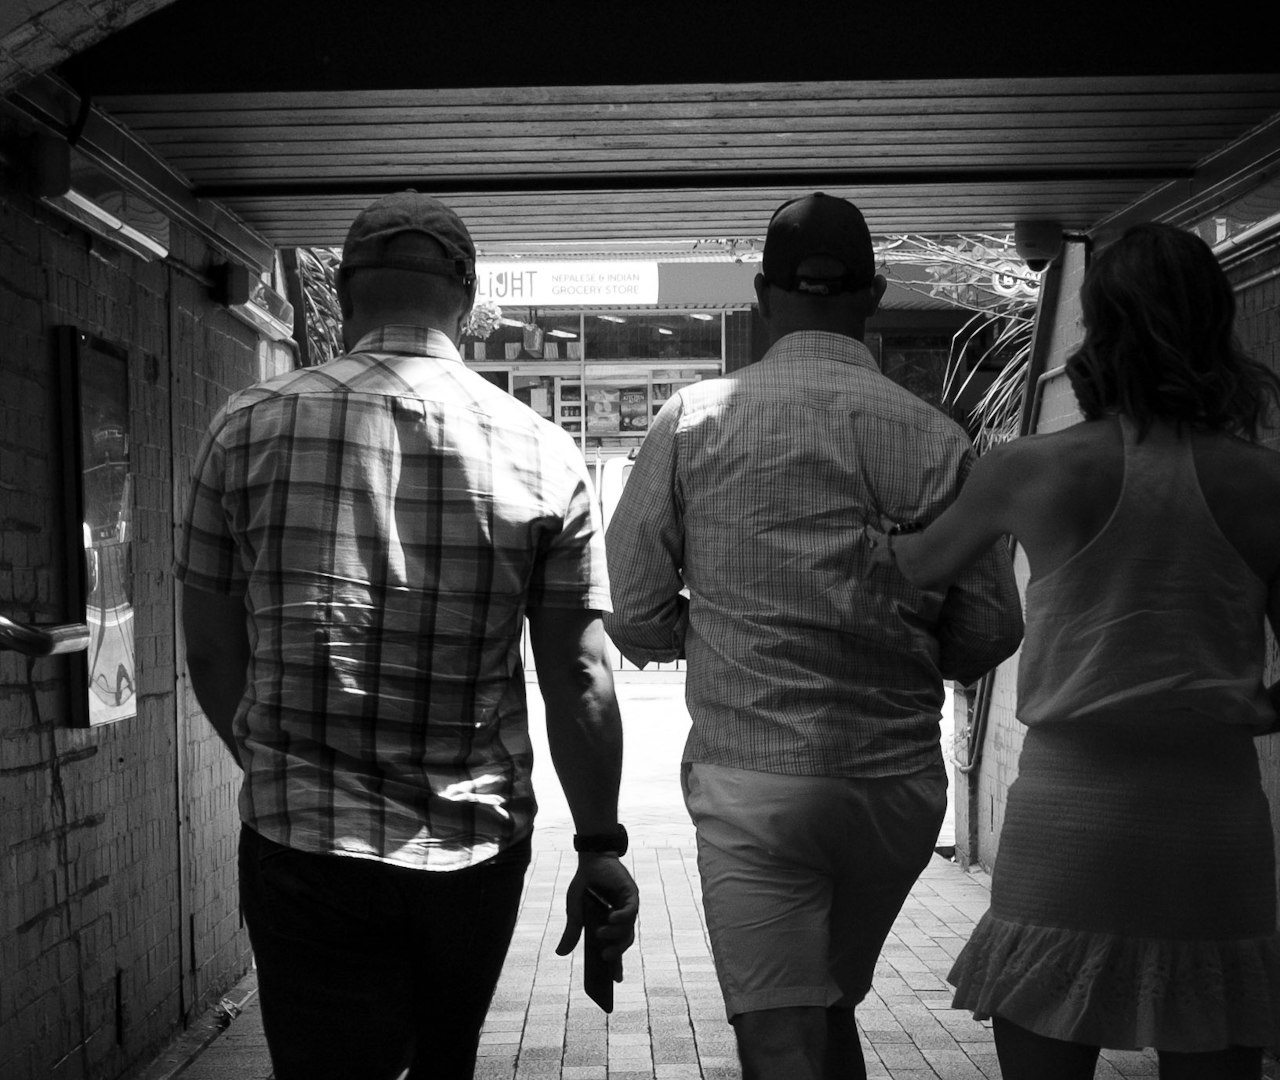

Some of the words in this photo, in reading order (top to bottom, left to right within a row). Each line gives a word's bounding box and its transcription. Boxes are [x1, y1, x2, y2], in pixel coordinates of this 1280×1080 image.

[551, 274, 597, 283] NEPALESE
[608, 273, 640, 282] INDIAN
[551, 285, 602, 295] GROCERY
[605, 284, 640, 294] STORE
